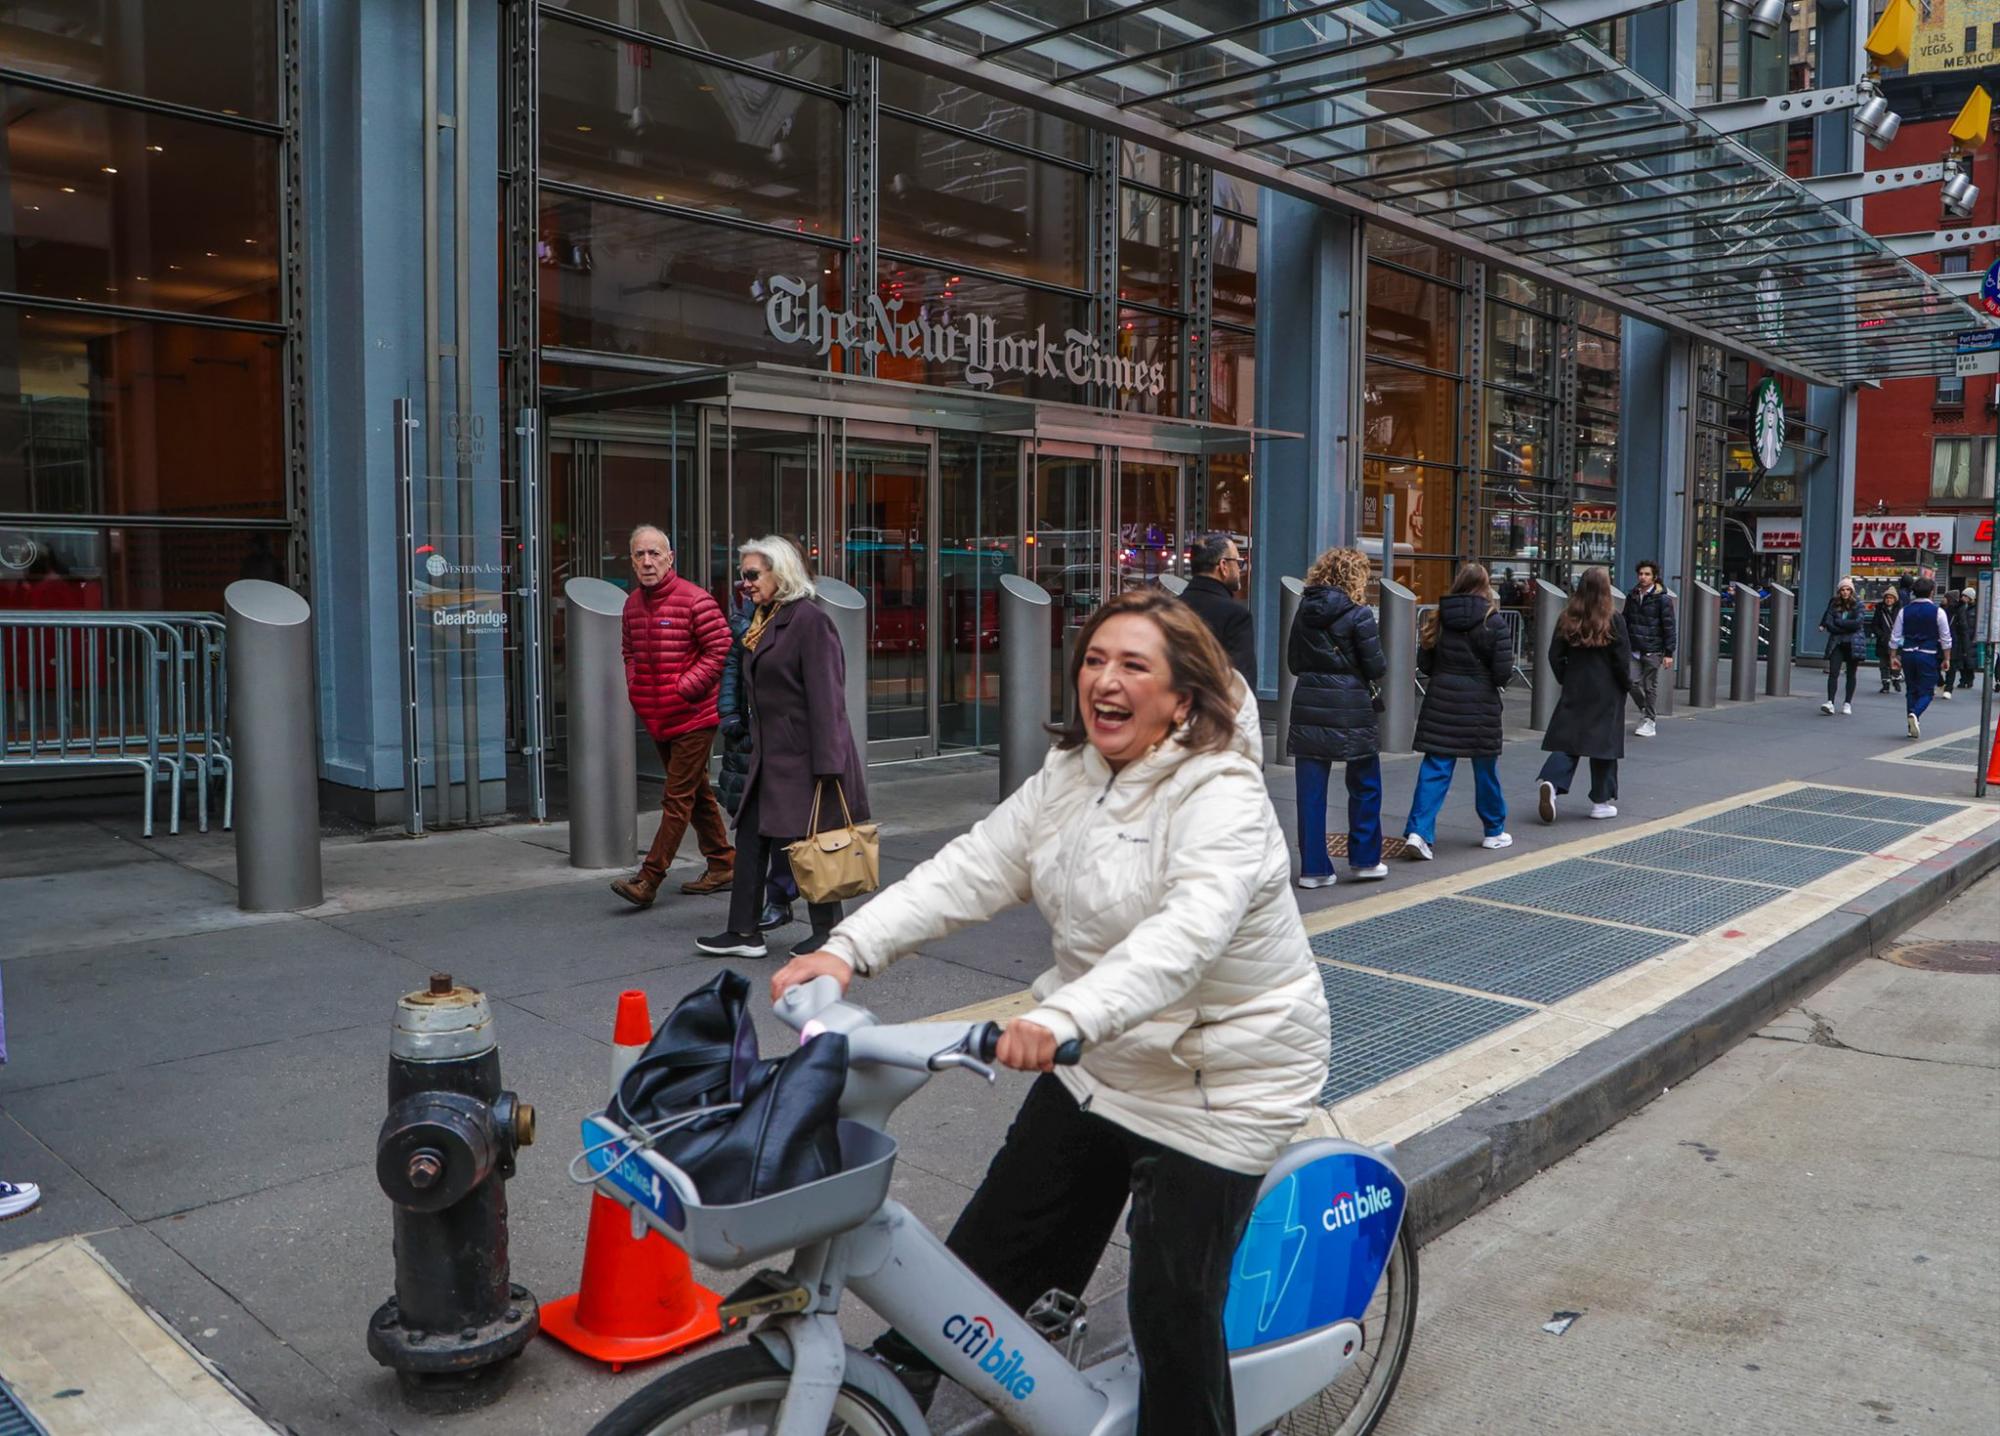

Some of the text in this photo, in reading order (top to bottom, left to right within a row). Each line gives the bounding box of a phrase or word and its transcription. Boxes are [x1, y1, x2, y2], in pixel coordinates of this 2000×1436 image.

[1927, 33, 1946, 44] LAS
[1920, 43, 1953, 57] VEGAS
[1943, 52, 1994, 69] MEXICO
[767, 275, 1166, 397] The New York Times
[1865, 523, 1880, 531] MY
[1882, 532, 1941, 549] CAFE
[433, 609, 508, 627] ClearBridge
[1322, 1184, 1392, 1232] citi bike
[942, 1314, 1036, 1400] citi bike
